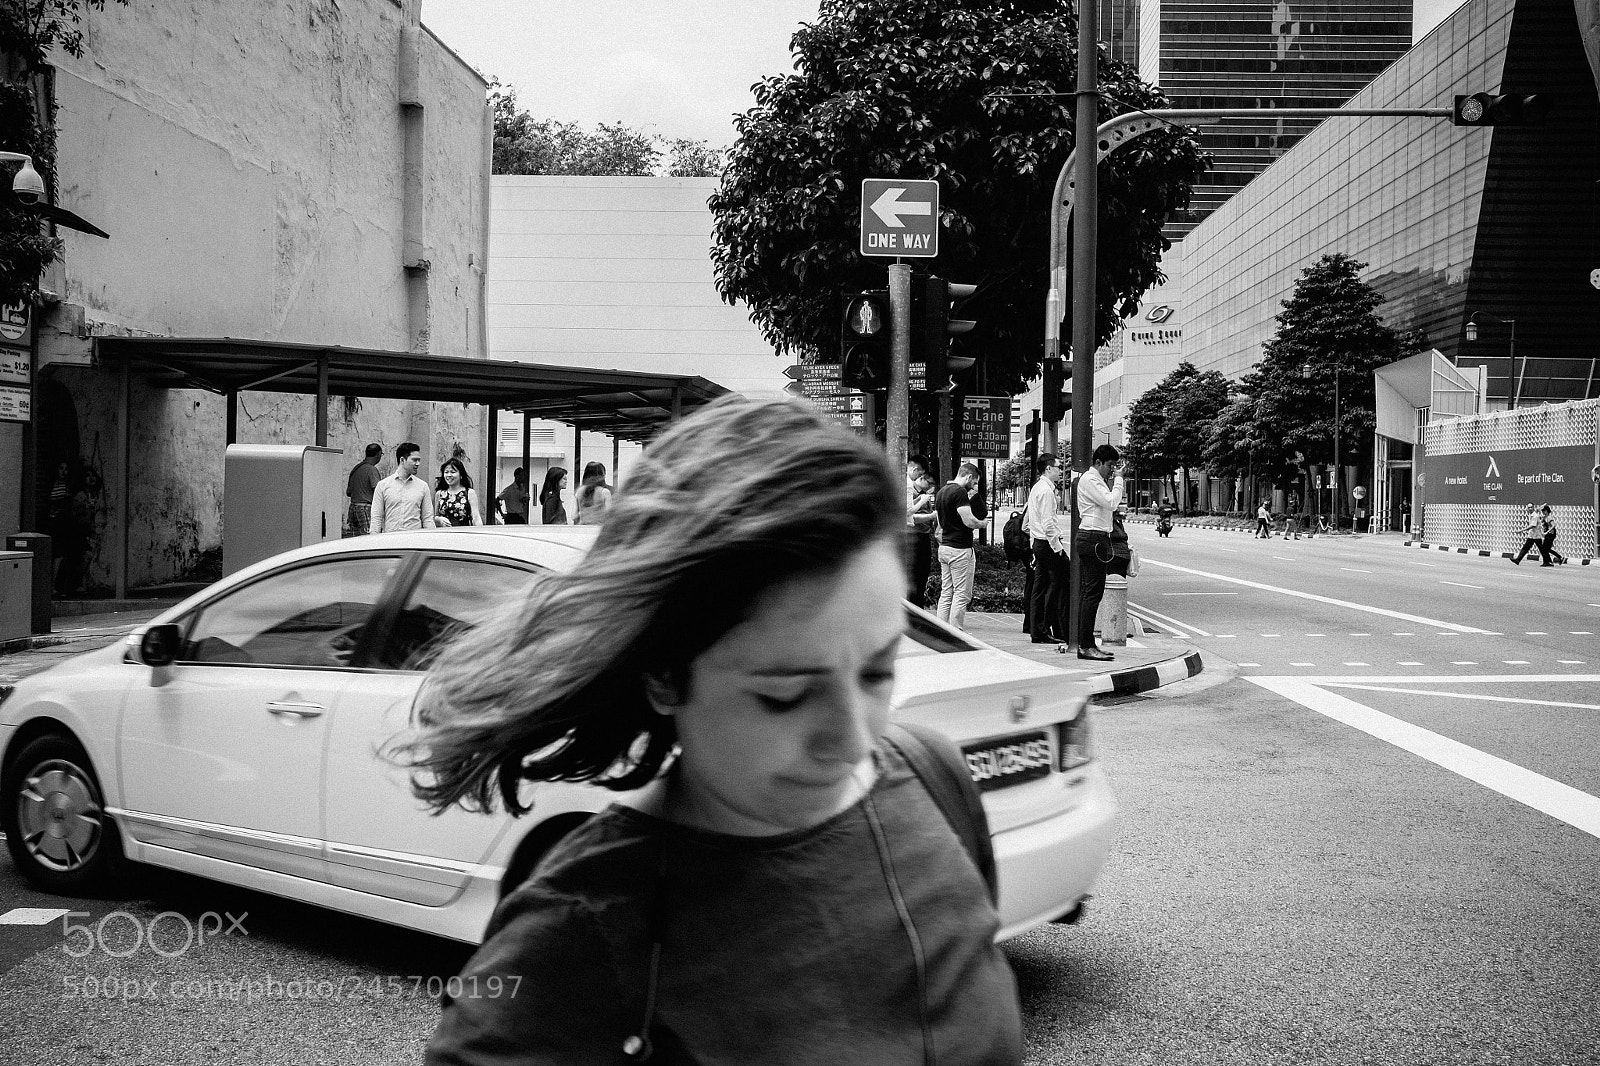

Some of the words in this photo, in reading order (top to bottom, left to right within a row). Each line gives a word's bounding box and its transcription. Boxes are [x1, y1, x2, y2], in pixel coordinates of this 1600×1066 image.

[868, 233, 896, 248] ONE
[903, 234, 931, 249] WAY
[14, 361, 30, 371] $1.20
[975, 409, 1004, 422] Lane
[1448, 477, 1457, 485] new
[1517, 473, 1525, 483] Be
[1524, 474, 1535, 485] part
[1535, 473, 1541, 483] of
[1541, 473, 1552, 483] The
[1483, 482, 1491, 491] THE
[1491, 482, 1503, 491] CLAN
